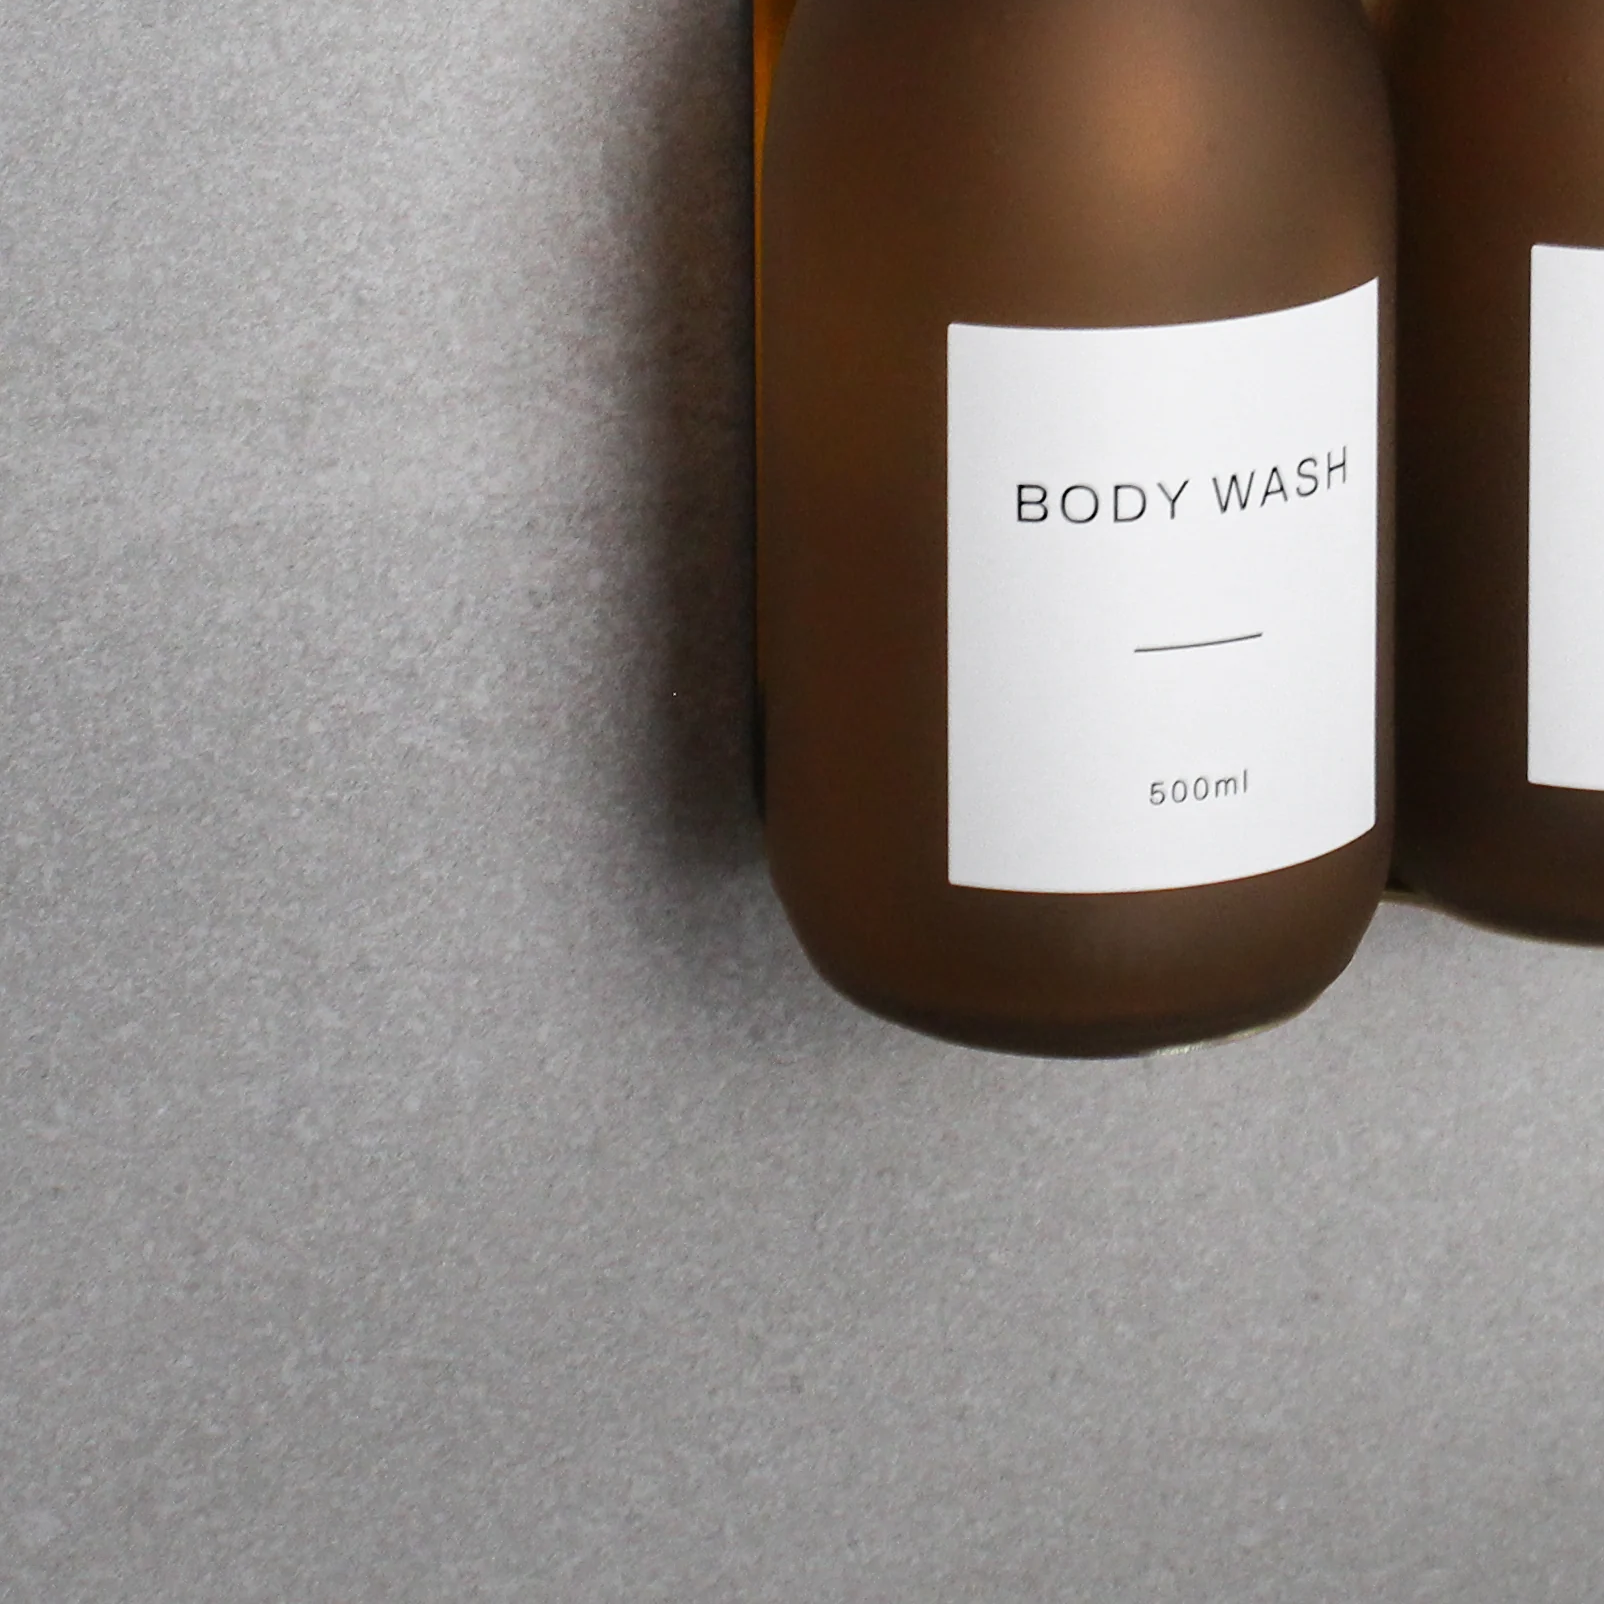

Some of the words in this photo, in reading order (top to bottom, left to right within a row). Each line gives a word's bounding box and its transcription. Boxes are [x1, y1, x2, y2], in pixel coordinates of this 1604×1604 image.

[1014, 478, 1191, 526] BODY
[1210, 444, 1349, 516] WASH
[1148, 768, 1249, 807] 500ml
